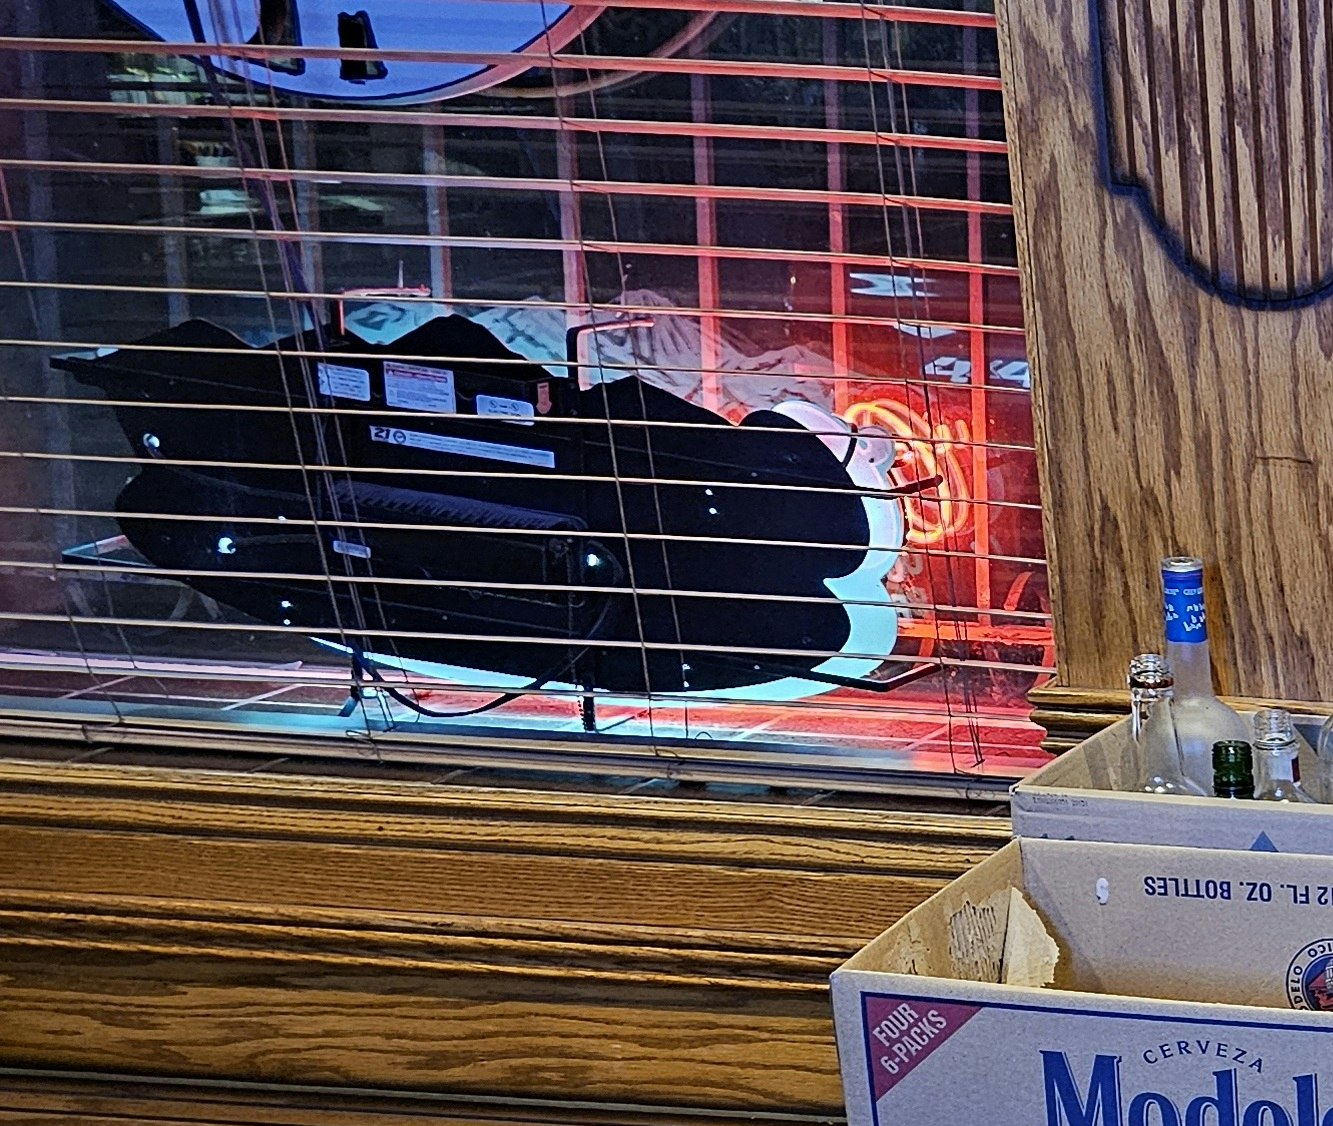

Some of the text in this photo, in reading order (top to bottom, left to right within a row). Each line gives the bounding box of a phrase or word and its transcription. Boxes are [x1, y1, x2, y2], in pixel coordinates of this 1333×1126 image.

[1144, 876, 1231, 900] BOTTLES
[1239, 882, 1272, 902] OZ.
[1280, 883, 1311, 904] FL.
[873, 1003, 919, 1046] FOUR
[880, 1009, 947, 1075] 6-PACKS
[1143, 1039, 1264, 1074] CERVEZA
